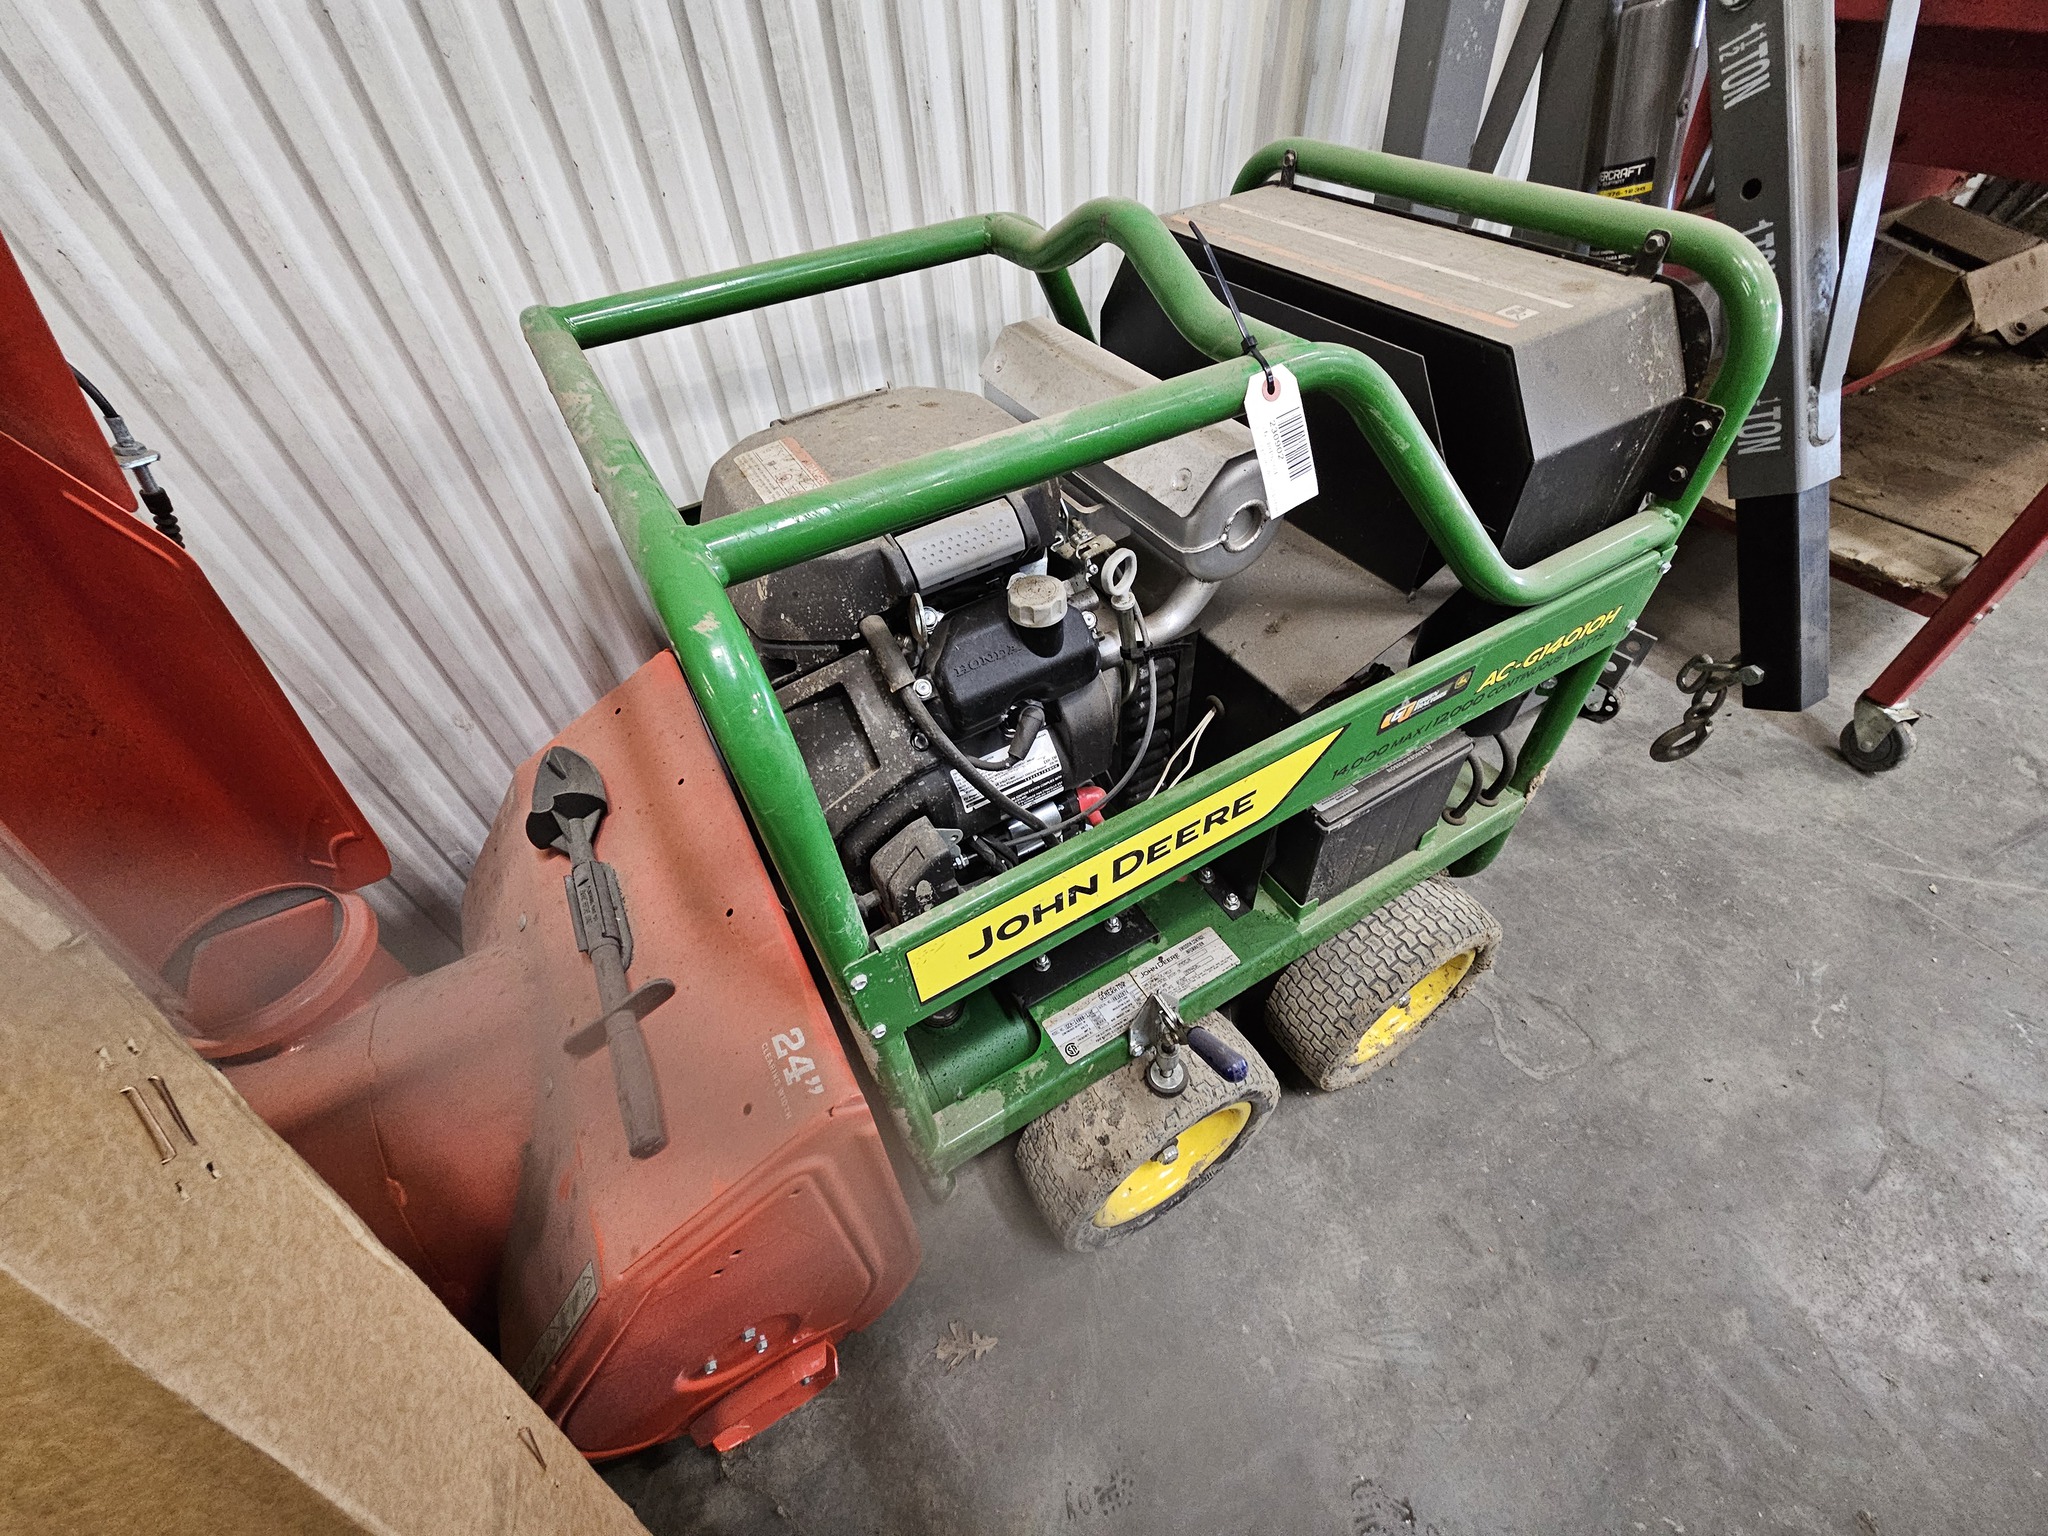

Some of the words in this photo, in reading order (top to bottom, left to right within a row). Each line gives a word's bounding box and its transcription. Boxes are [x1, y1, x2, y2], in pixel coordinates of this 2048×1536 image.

[1721, 40, 1771, 110] TON
[1737, 405, 1783, 456] TON
[1476, 604, 1624, 694] AC-G14010H
[1331, 743, 1391, 780] 14,000
[1391, 724, 1426, 748] MAX
[1486, 652, 1566, 699] CONTINUOUS
[1567, 630, 1607, 657] WATTS
[968, 873, 1099, 960] JOHN
[1112, 789, 1258, 884] DEERE
[1140, 965, 1159, 979] JOHN
[1157, 952, 1181, 968] DEERE
[761, 1042, 781, 1087] CLEARING
